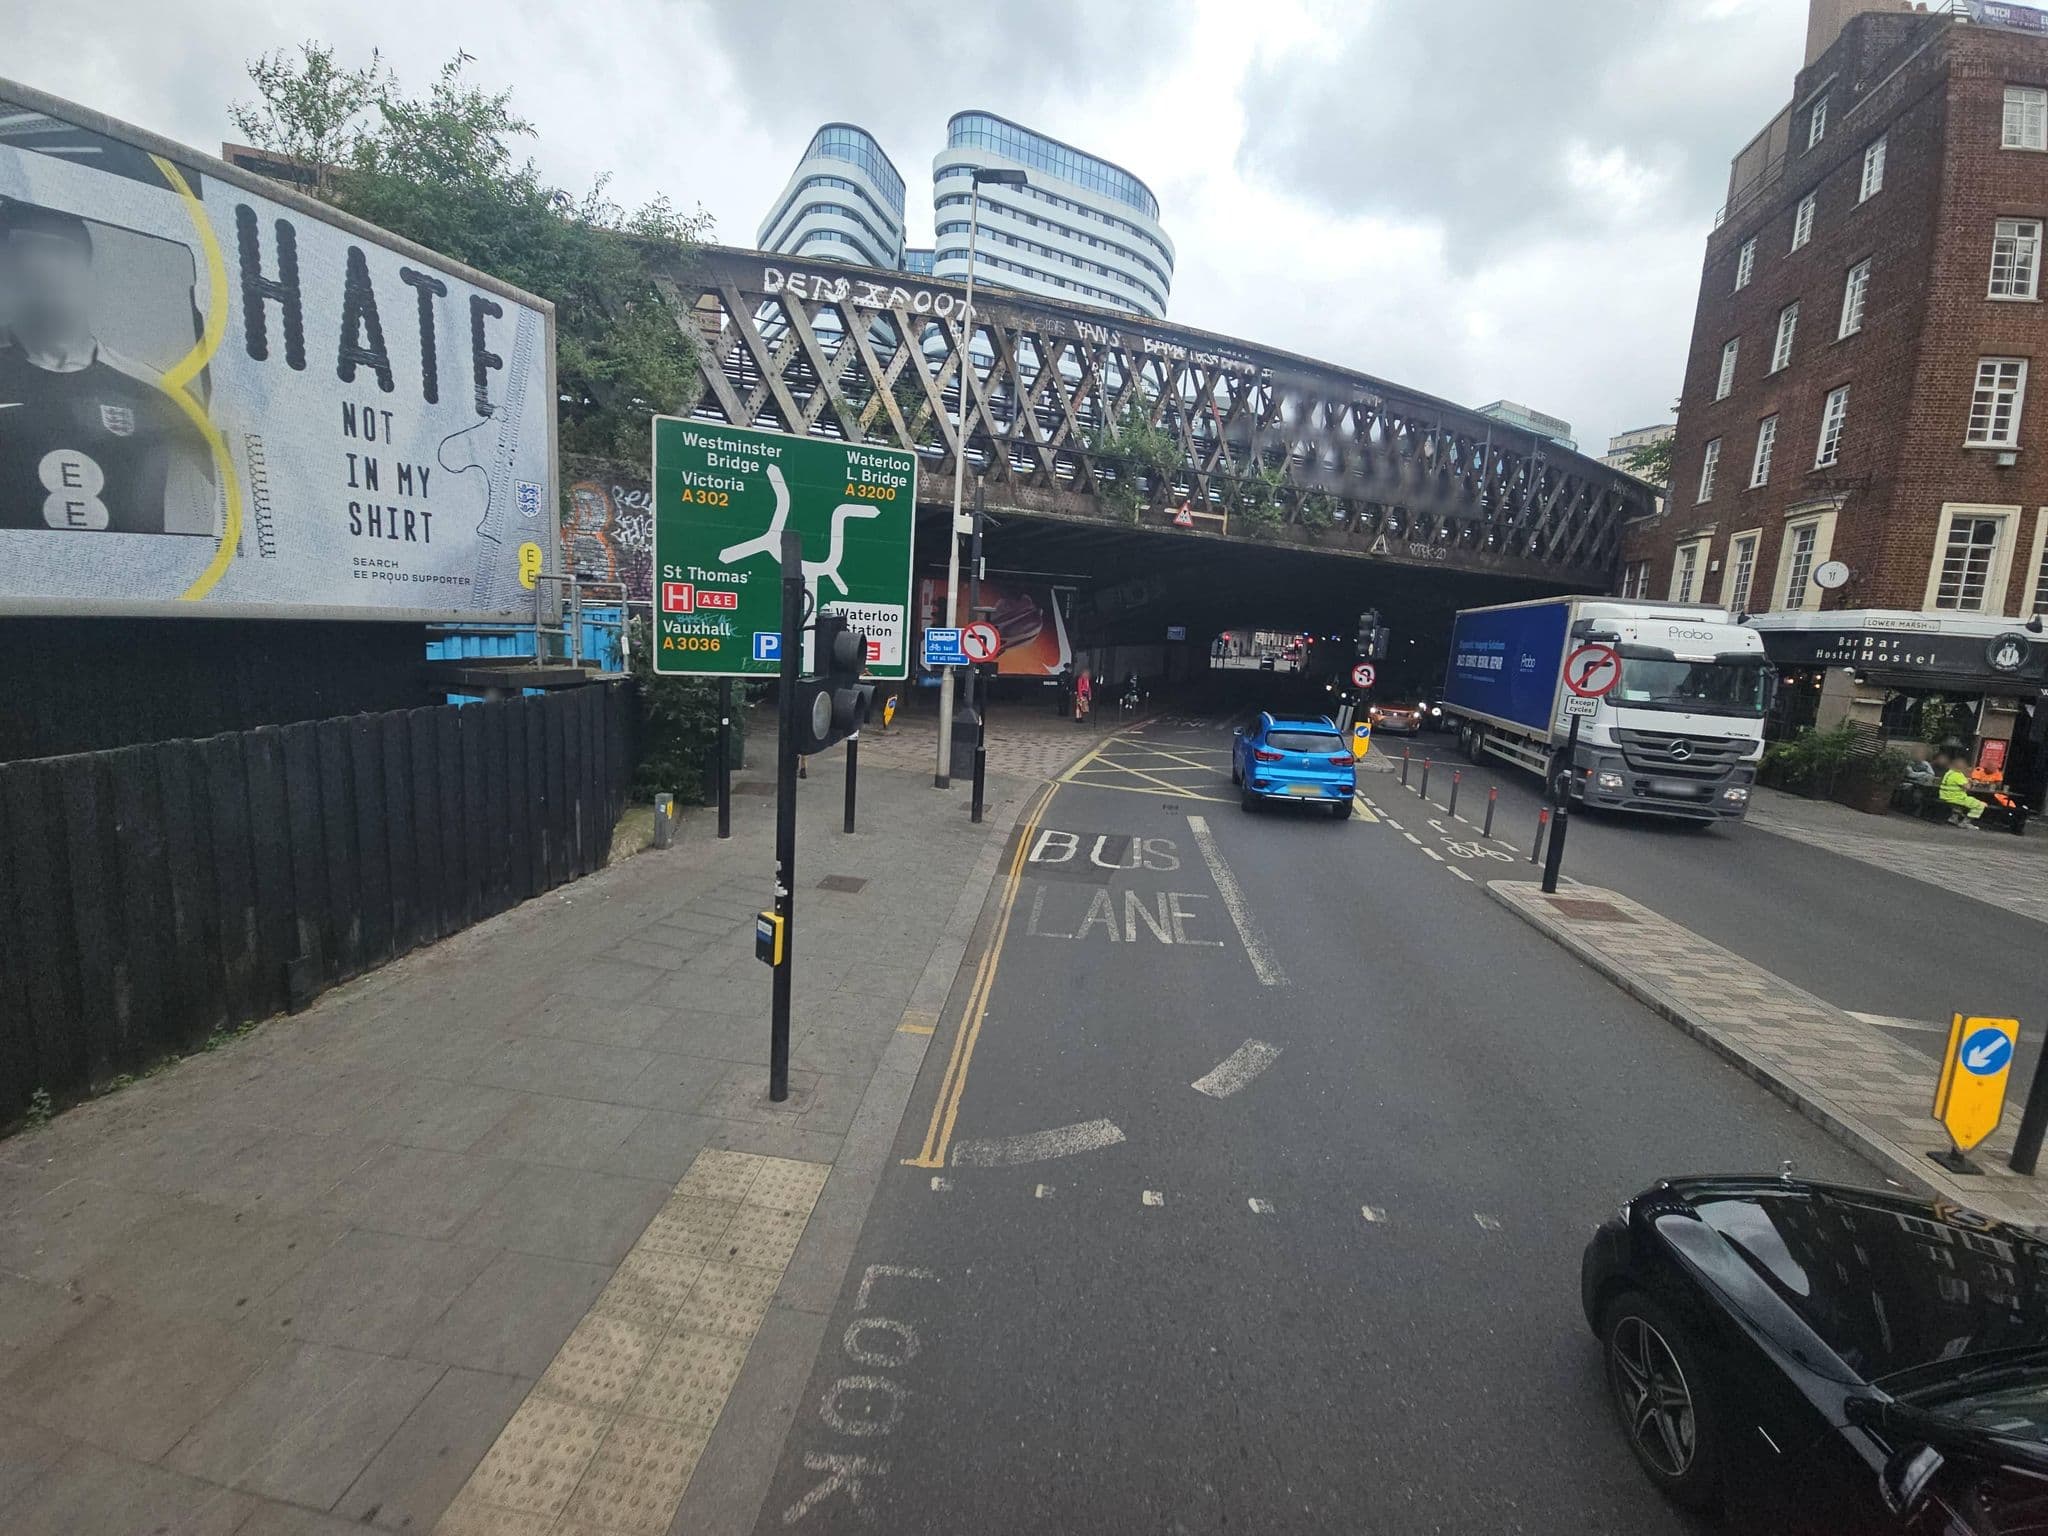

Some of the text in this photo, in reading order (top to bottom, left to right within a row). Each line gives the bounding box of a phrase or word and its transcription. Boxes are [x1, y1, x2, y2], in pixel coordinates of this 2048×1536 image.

[342, 401, 394, 444] NOT
[682, 432, 782, 458] Westminster
[707, 452, 760, 474] Bridge
[846, 451, 911, 472] Waterloo
[346, 453, 430, 499] IN MY
[682, 471, 745, 492] Victoria
[861, 470, 908, 488] Bridge
[348, 501, 433, 544] SHIRT
[353, 557, 399, 569] SEARCH
[663, 564, 682, 580] St
[353, 570, 471, 586] EE PROUD SUPPORTER
[667, 586, 689, 609] H
[836, 608, 898, 622] Waterloo
[1867, 619, 1896, 627] LOWER
[663, 619, 731, 636] Vauxhall
[1668, 626, 1714, 640] Probo
[760, 636, 779, 658] P
[1838, 636, 1859, 647] Bar
[1864, 637, 1900, 649] Bar
[1816, 649, 1856, 661] Hostel
[1861, 650, 1936, 665] Hostel
[1570, 698, 1595, 707] Except
[1028, 829, 1180, 872] BUS
[1025, 884, 1225, 947] LANE
[783, 1264, 941, 1524] LOOK
